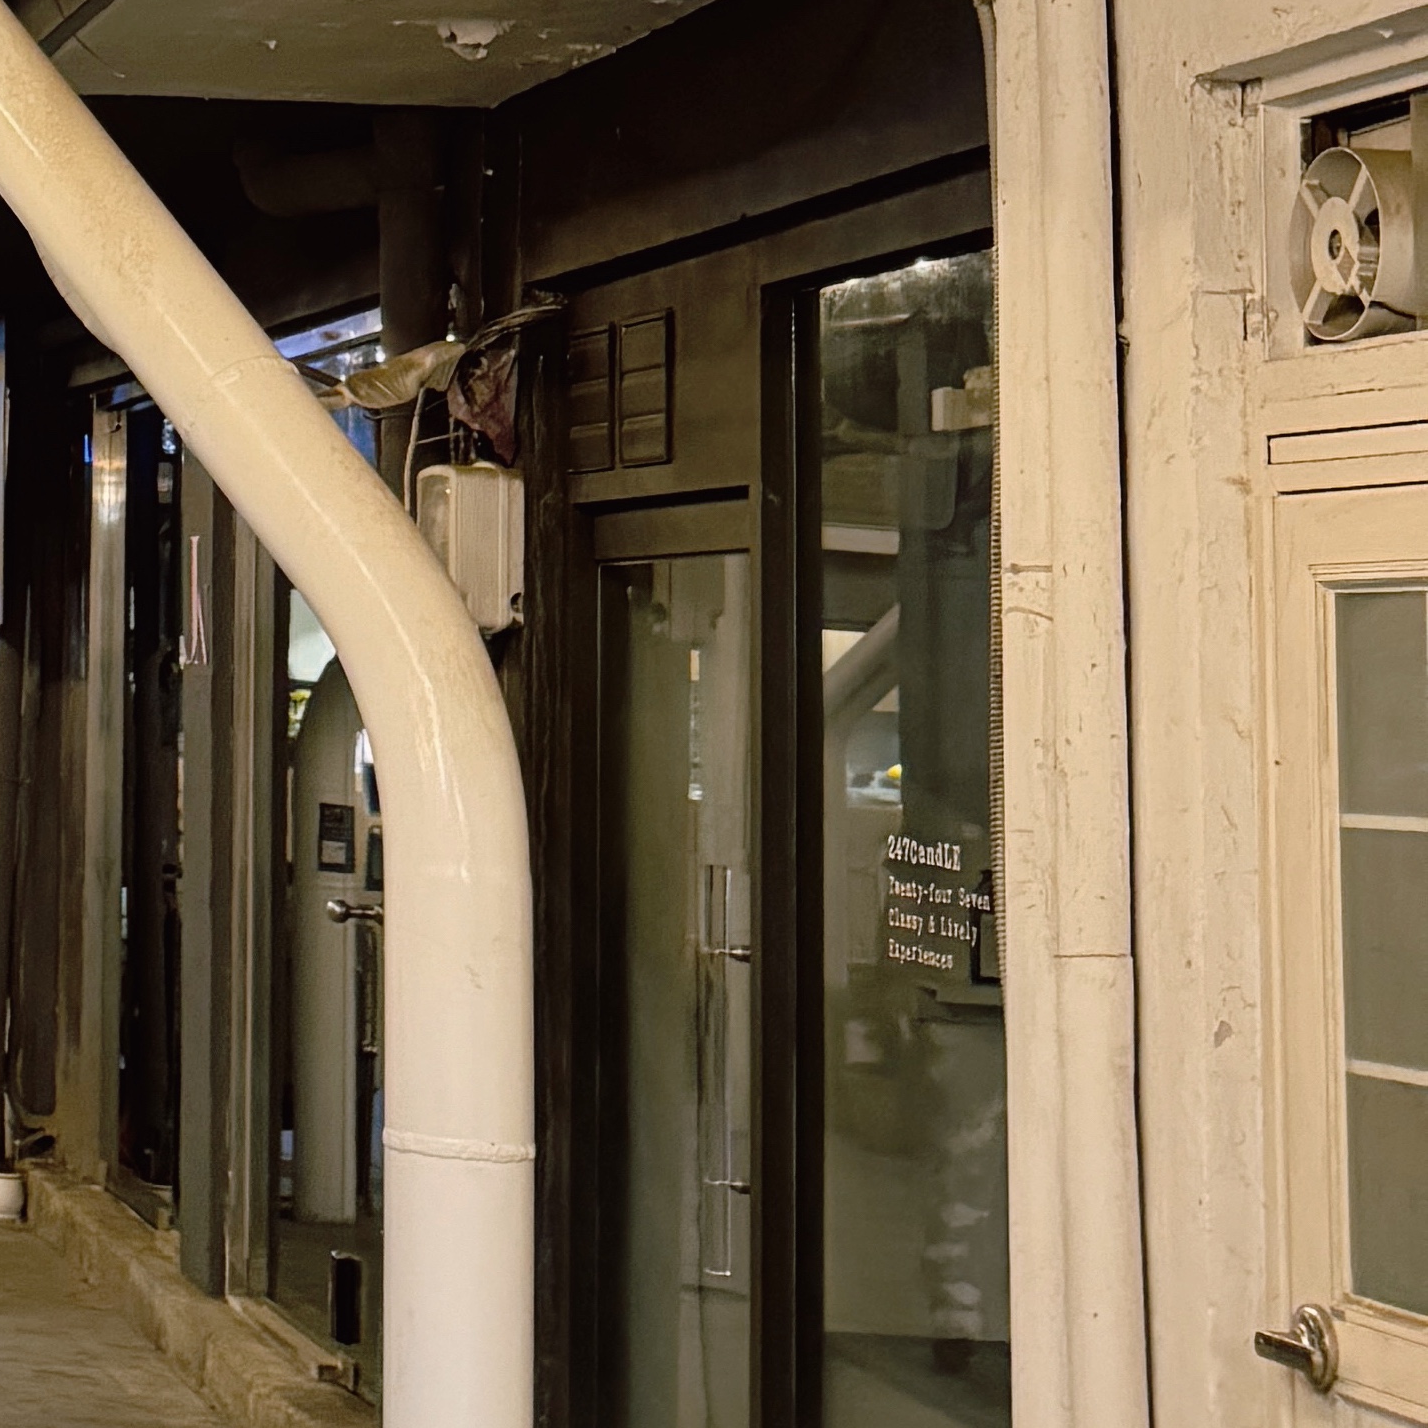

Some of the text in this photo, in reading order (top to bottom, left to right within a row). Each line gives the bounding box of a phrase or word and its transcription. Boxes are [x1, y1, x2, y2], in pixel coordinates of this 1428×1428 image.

[958, 887, 991, 911] Seven
[888, 907, 923, 936] Classy
[940, 915, 978, 948] Lively
[888, 938, 954, 970] Experiences
